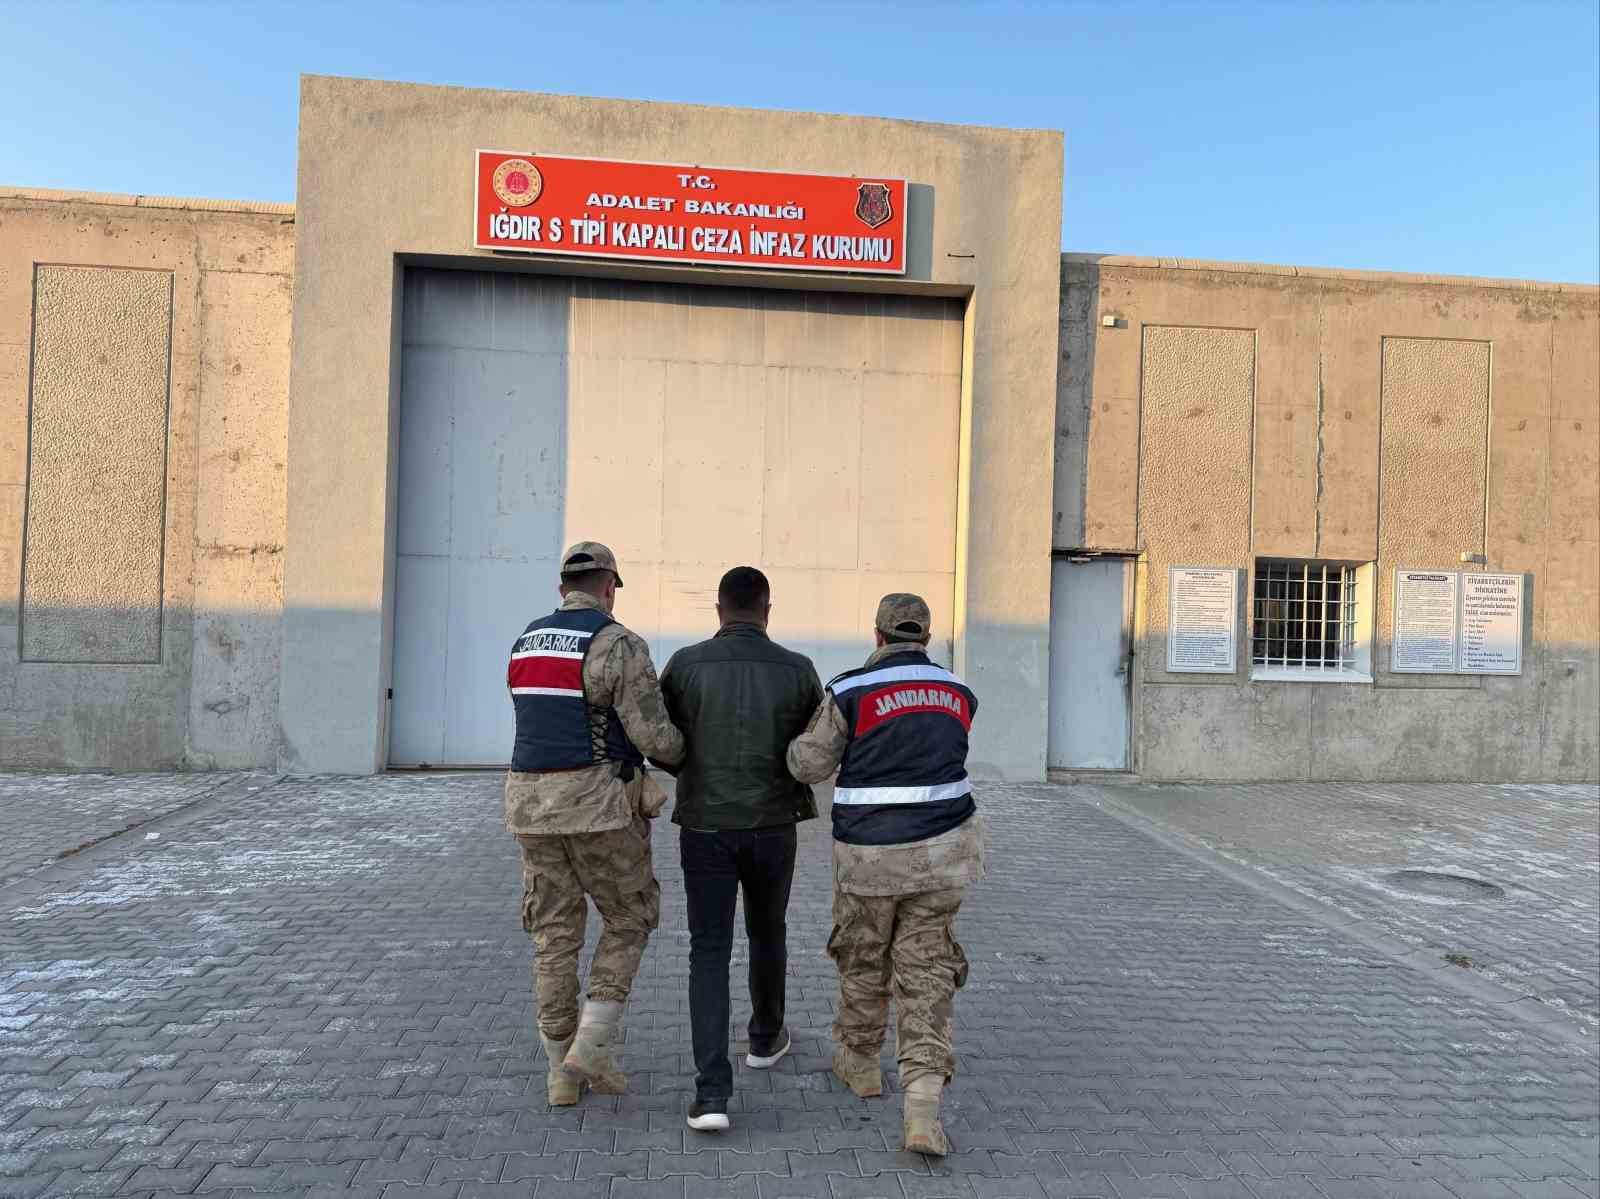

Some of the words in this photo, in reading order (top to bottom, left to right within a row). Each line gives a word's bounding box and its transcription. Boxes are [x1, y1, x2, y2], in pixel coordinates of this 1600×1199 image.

[677, 174, 716, 190] T.C.
[586, 192, 676, 212] ADALET
[684, 199, 805, 220] BAKANLIĞI
[489, 207, 541, 241] IĞDIR
[549, 216, 562, 242] S
[571, 213, 606, 246] TİPİ
[612, 221, 684, 250] KAPALI
[691, 225, 743, 255] CEZA
[750, 223, 806, 258] İNFAZ
[812, 234, 892, 263] KURUMU
[519, 633, 580, 653] JANDARMA
[875, 688, 961, 717] JANDARMA
